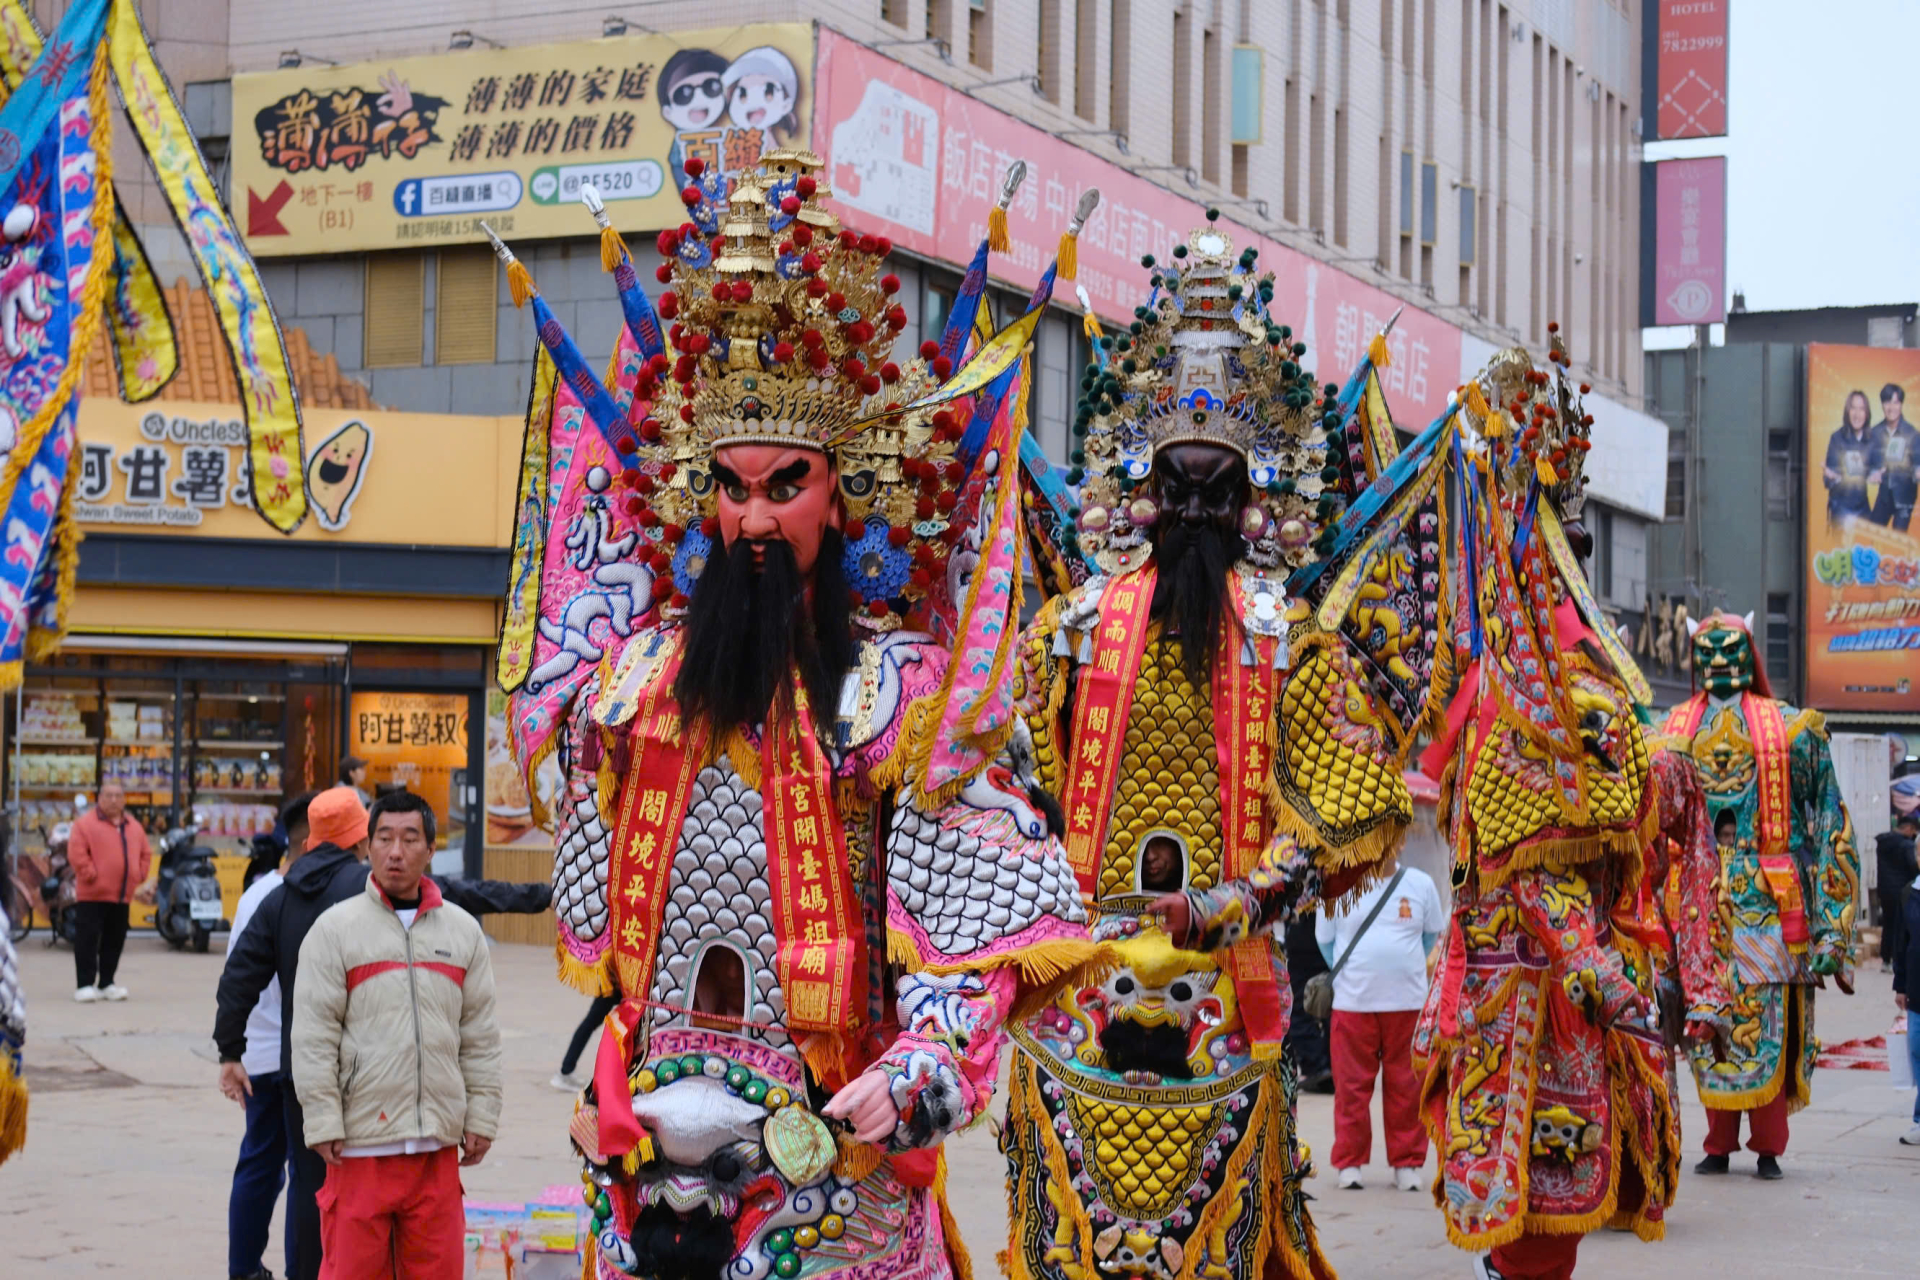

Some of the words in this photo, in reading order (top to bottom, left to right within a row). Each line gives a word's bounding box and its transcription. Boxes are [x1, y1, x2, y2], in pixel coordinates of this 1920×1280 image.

[1671, 2, 1717, 17] HOTEL
[1663, 36, 1723, 54] 7822999
[464, 63, 654, 115] 薄薄的家庭
[449, 111, 636, 162] 薄薄的價格
[301, 181, 374, 206] 地下一樓
[319, 209, 354, 232] (B1)
[113, 506, 153, 520] Sweet
[158, 508, 199, 523] Potato
[359, 713, 456, 746] 阿甘薯叔
